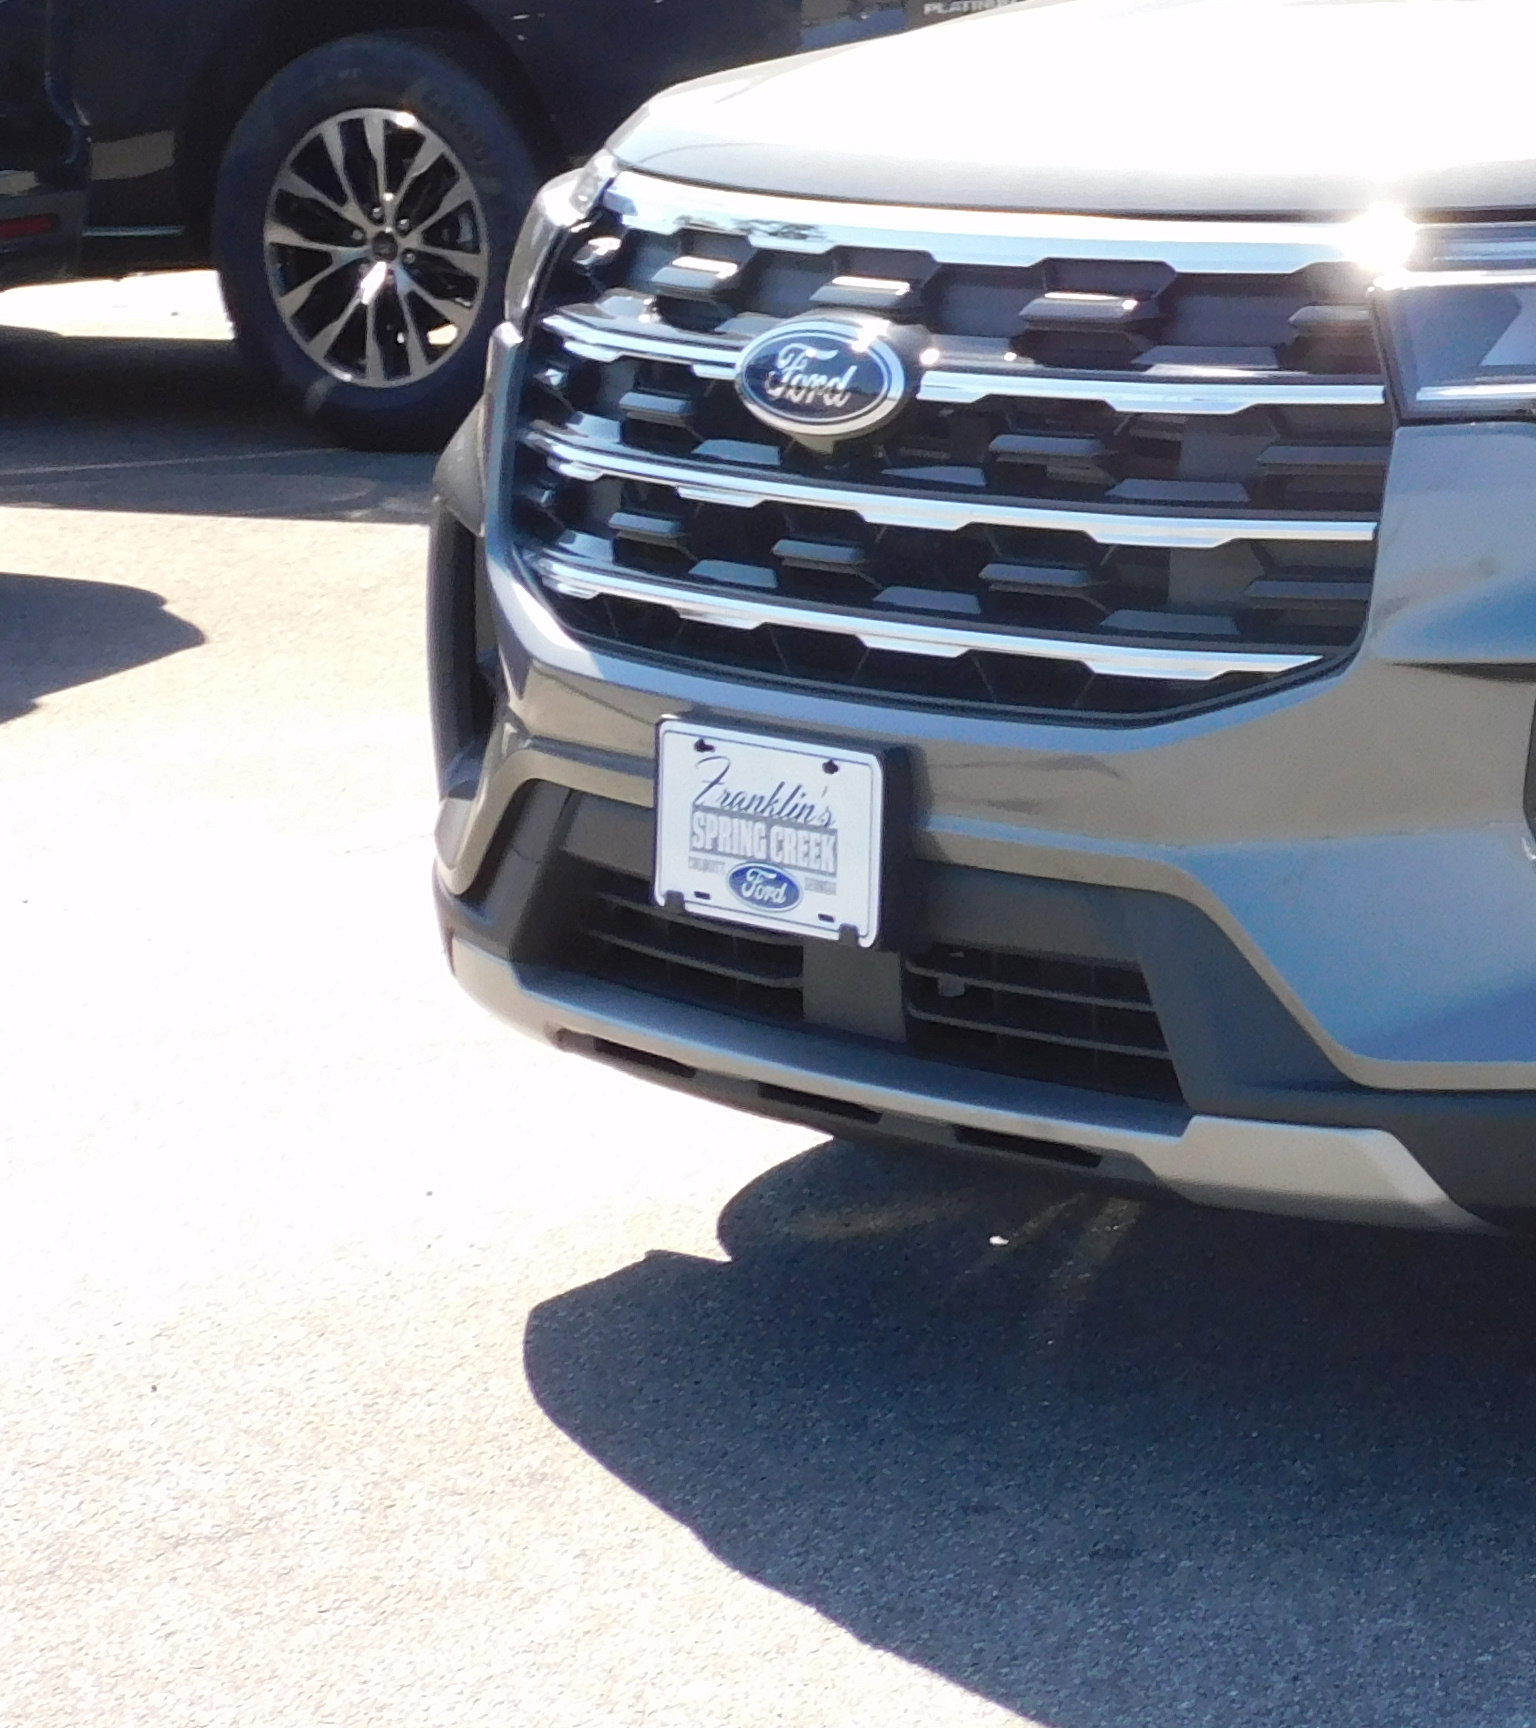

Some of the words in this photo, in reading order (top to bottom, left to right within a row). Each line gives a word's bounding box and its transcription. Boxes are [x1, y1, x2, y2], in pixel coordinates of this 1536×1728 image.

[763, 342, 858, 408] Ford
[692, 755, 836, 828] Franklin's
[691, 810, 768, 861] SPRING
[769, 824, 837, 876] CREEK
[741, 867, 788, 904] Ford
